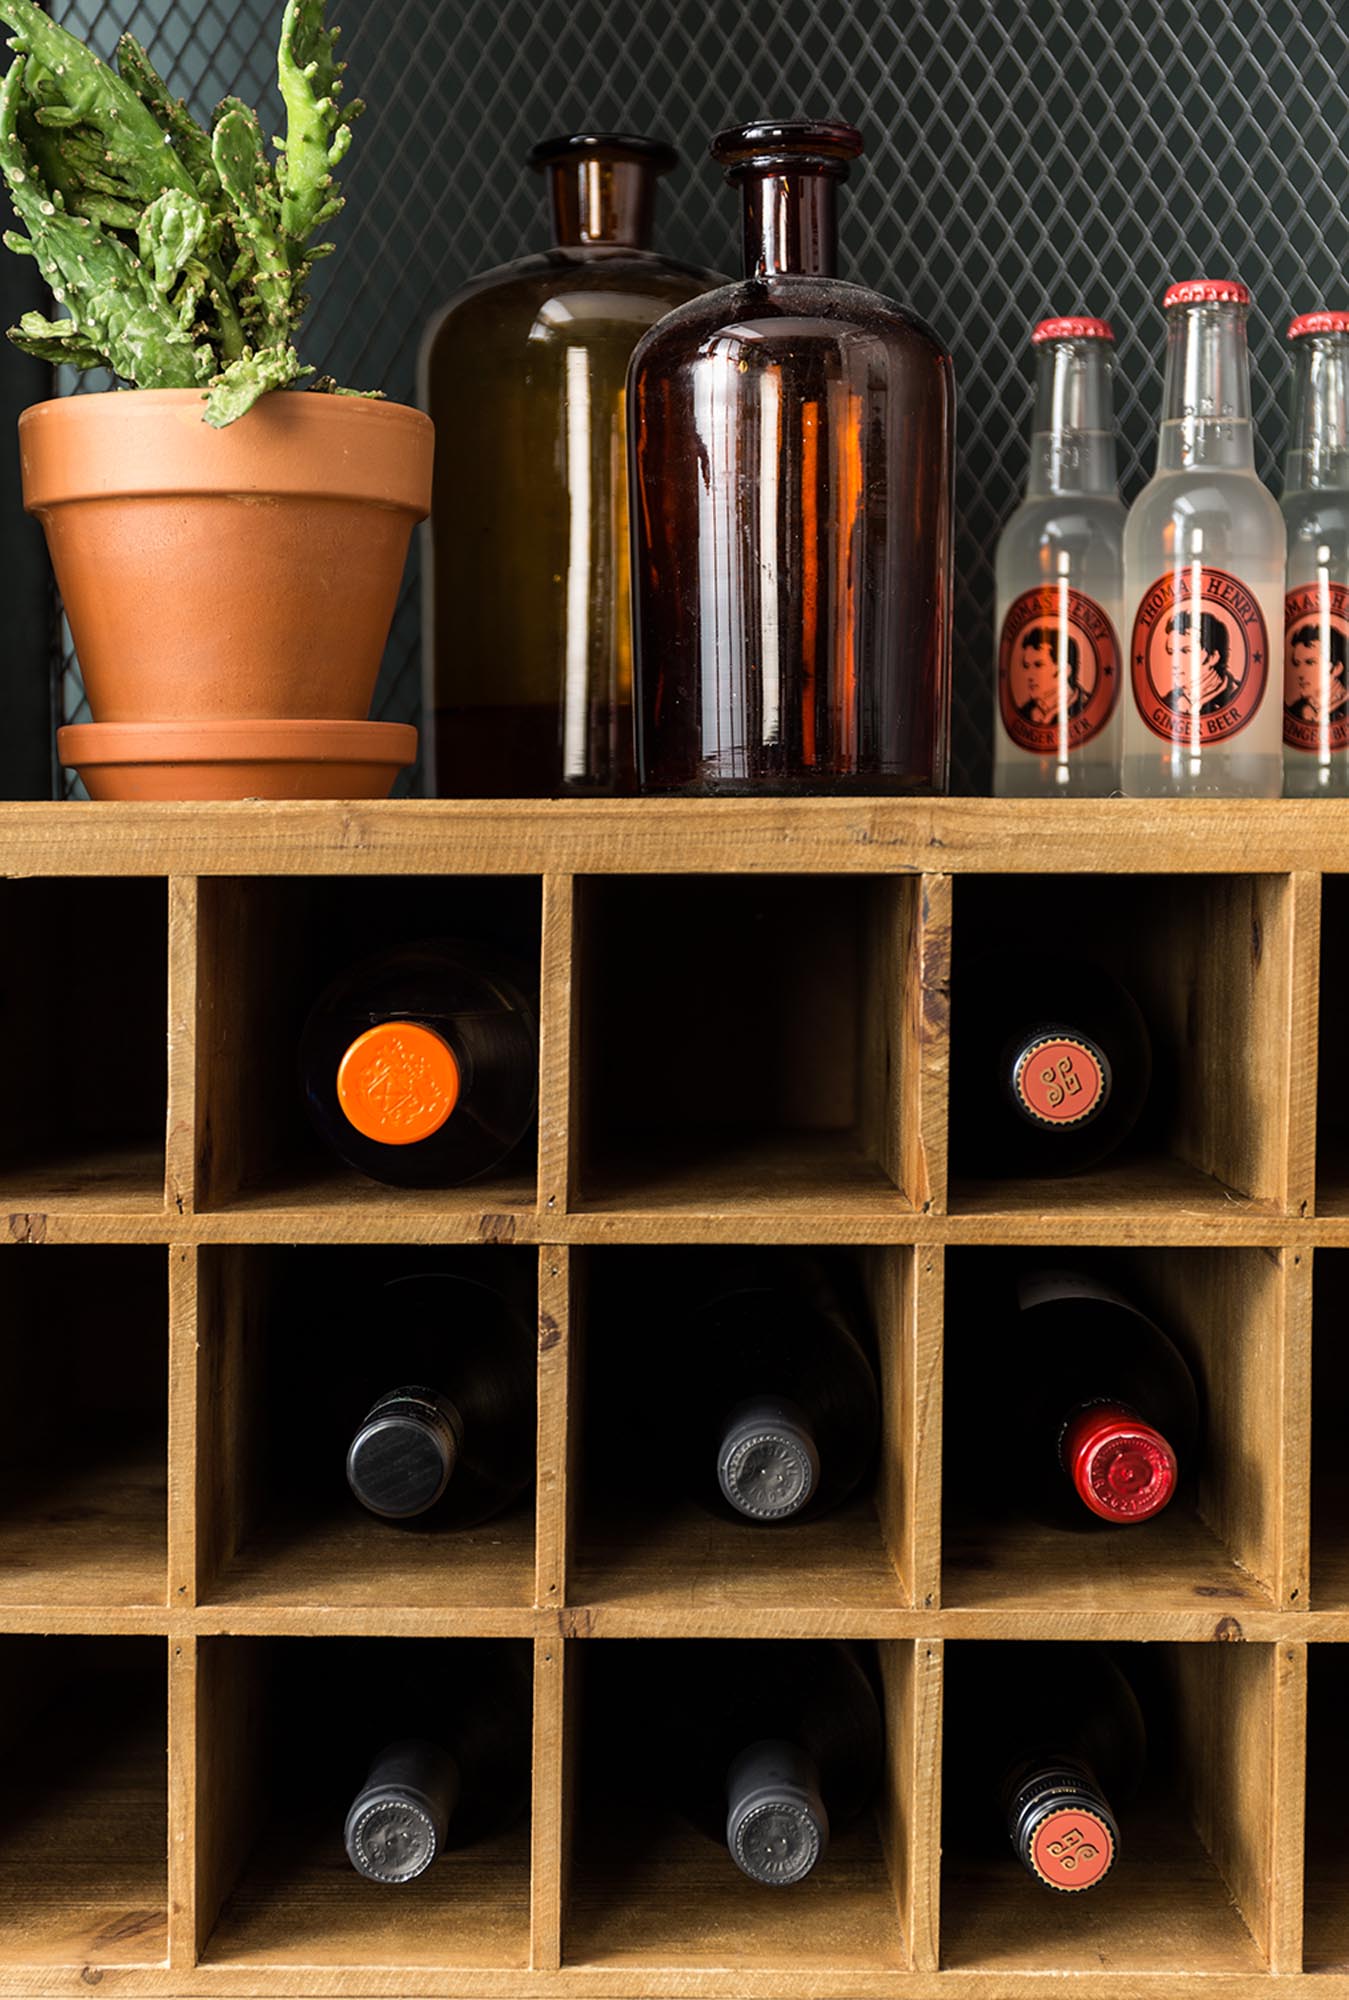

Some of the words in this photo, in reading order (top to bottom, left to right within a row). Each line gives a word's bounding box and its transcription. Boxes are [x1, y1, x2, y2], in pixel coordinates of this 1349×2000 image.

[1067, 598, 1109, 640] ENRY
[1141, 578, 1194, 628] THOMA
[1206, 577, 1258, 626] HENRY
[1206, 707, 1242, 734] BEER
